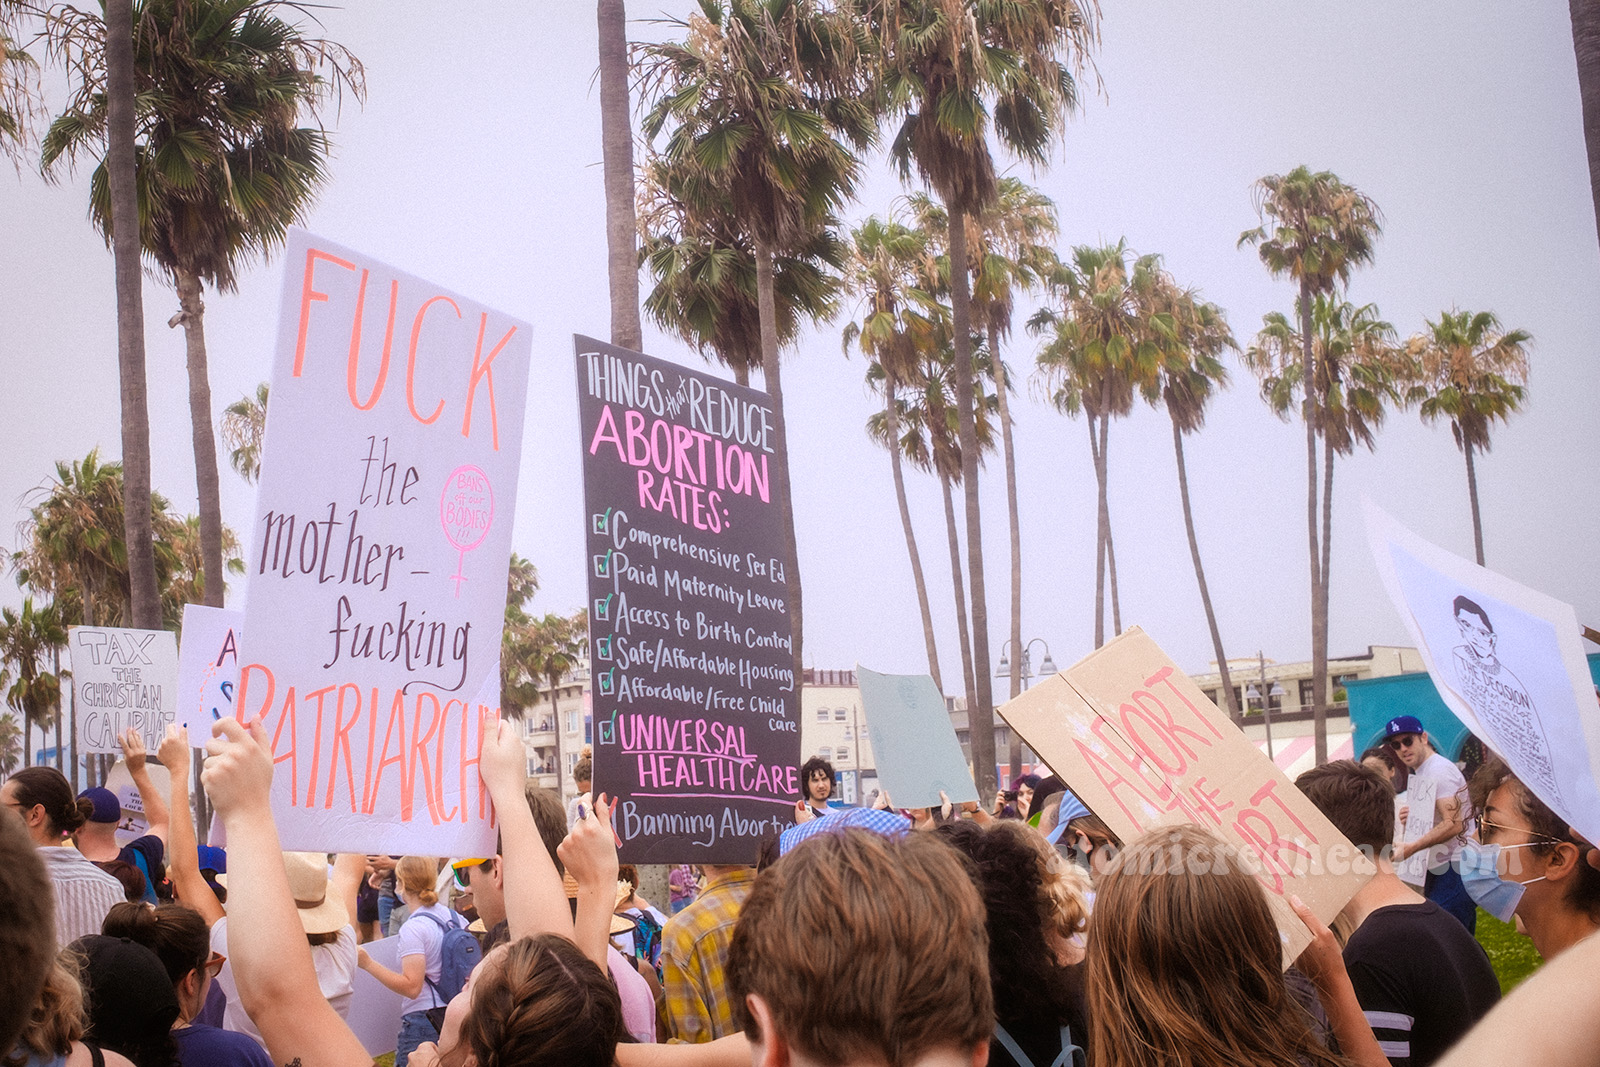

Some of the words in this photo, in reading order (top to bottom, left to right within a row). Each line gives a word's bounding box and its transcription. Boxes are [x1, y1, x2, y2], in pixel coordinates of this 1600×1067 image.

[293, 248, 517, 452] FUCK
[579, 352, 665, 417] THINGS
[664, 375, 690, 420] that
[689, 377, 774, 454] REDUCE
[360, 435, 420, 507] the
[589, 405, 770, 504] ABORTION
[457, 473, 484, 493] BANS
[638, 469, 730, 534] RATES:
[446, 501, 488, 530] BODIES
[259, 502, 430, 591] mother-
[612, 510, 741, 573] Comprehensive
[746, 553, 767, 578] Sex
[770, 558, 786, 585] Ed
[612, 552, 658, 596] Paid
[664, 570, 744, 614] Maternity
[747, 589, 786, 614] Leave
[78, 631, 156, 665] TAX
[323, 595, 472, 696] fucking
[614, 591, 671, 636] Access
[675, 610, 690, 637] to
[696, 611, 741, 645] Birth
[745, 627, 793, 655] Control
[111, 667, 142, 683] THE
[616, 636, 737, 676] Safe/Affordable
[739, 658, 795, 691] Housing
[1459, 657, 1481, 683] THE
[1481, 671, 1532, 710] DECISION
[81, 681, 162, 711] CHRISTIAN
[617, 675, 745, 711] Affordable/Free
[750, 696, 785, 718] Child
[619, 713, 757, 759] UNIVERSAL
[768, 717, 797, 733] care
[1072, 666, 1224, 833] ABORT
[622, 801, 716, 847] Banning
[718, 806, 797, 838] Abortio
[1165, 777, 1234, 828] THE
